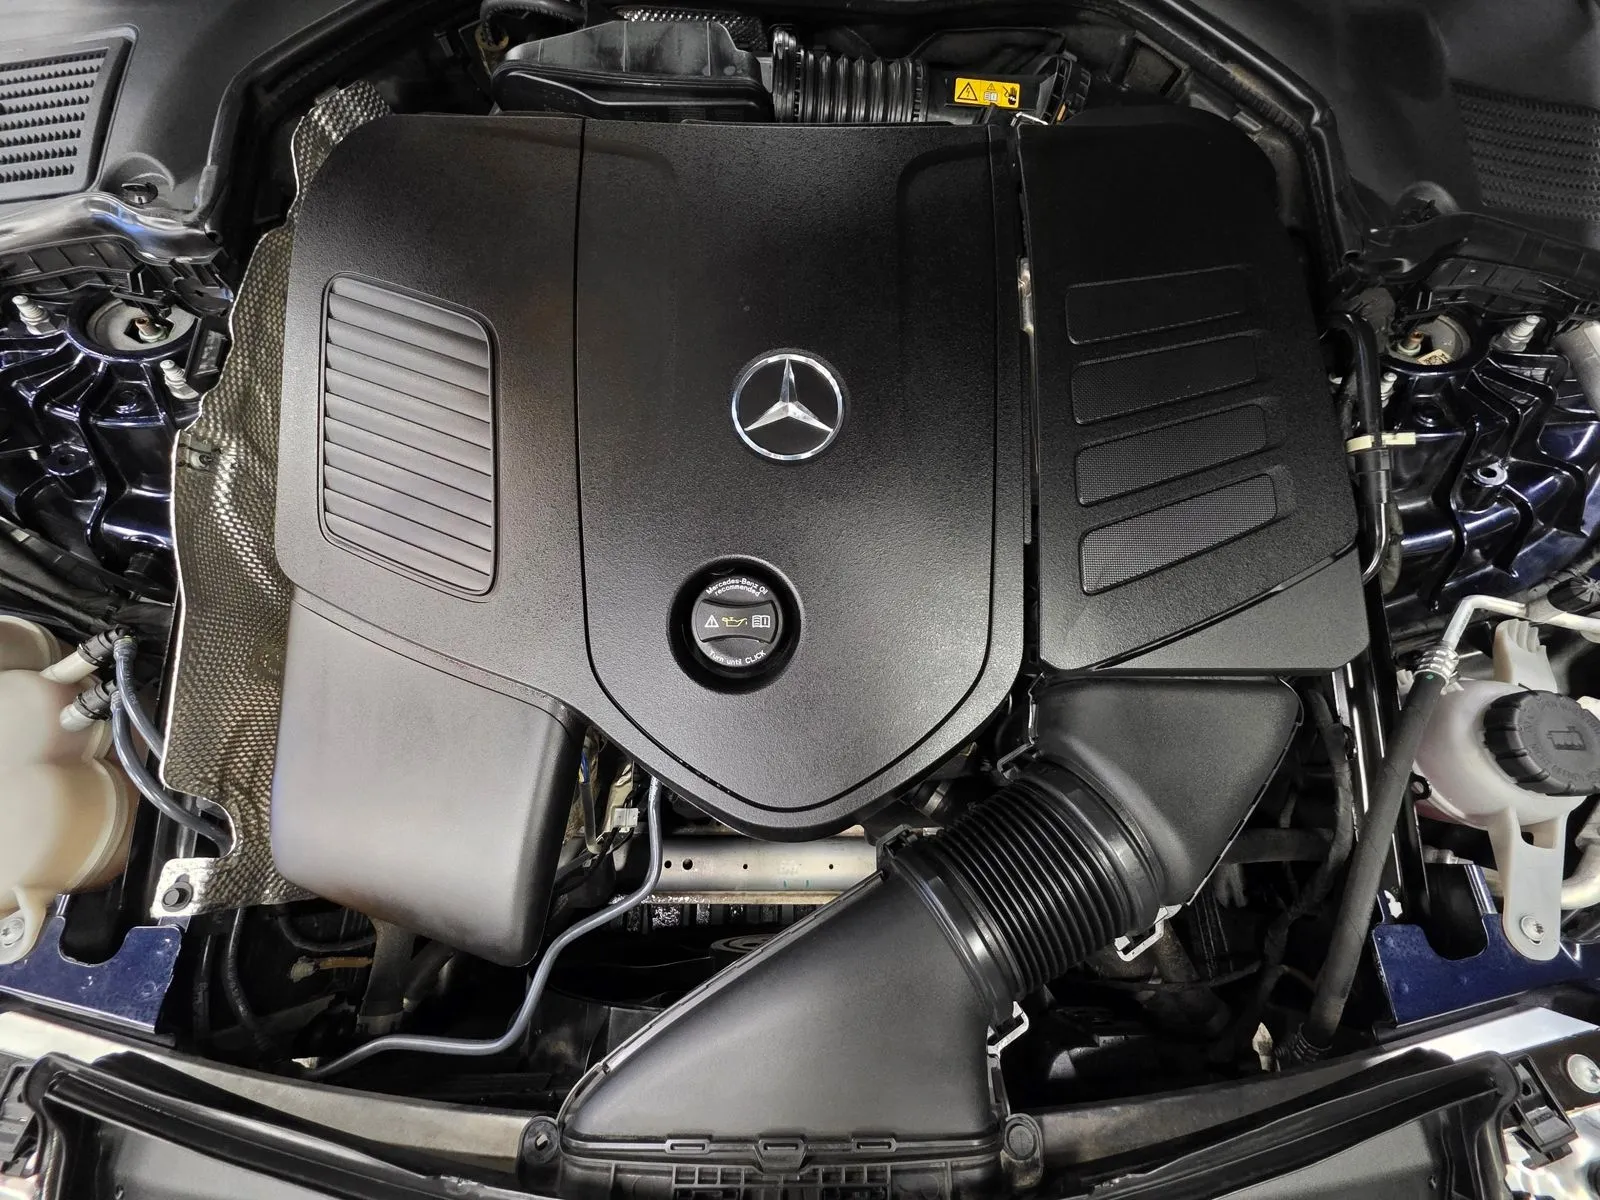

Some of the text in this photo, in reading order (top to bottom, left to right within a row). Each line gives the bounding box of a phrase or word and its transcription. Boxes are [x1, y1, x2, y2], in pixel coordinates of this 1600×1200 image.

[705, 577, 769, 595] Mercedes-Benz Oil
[714, 584, 761, 597] recommended
[709, 650, 724, 663] Turn
[745, 649, 767, 664] CLICK
